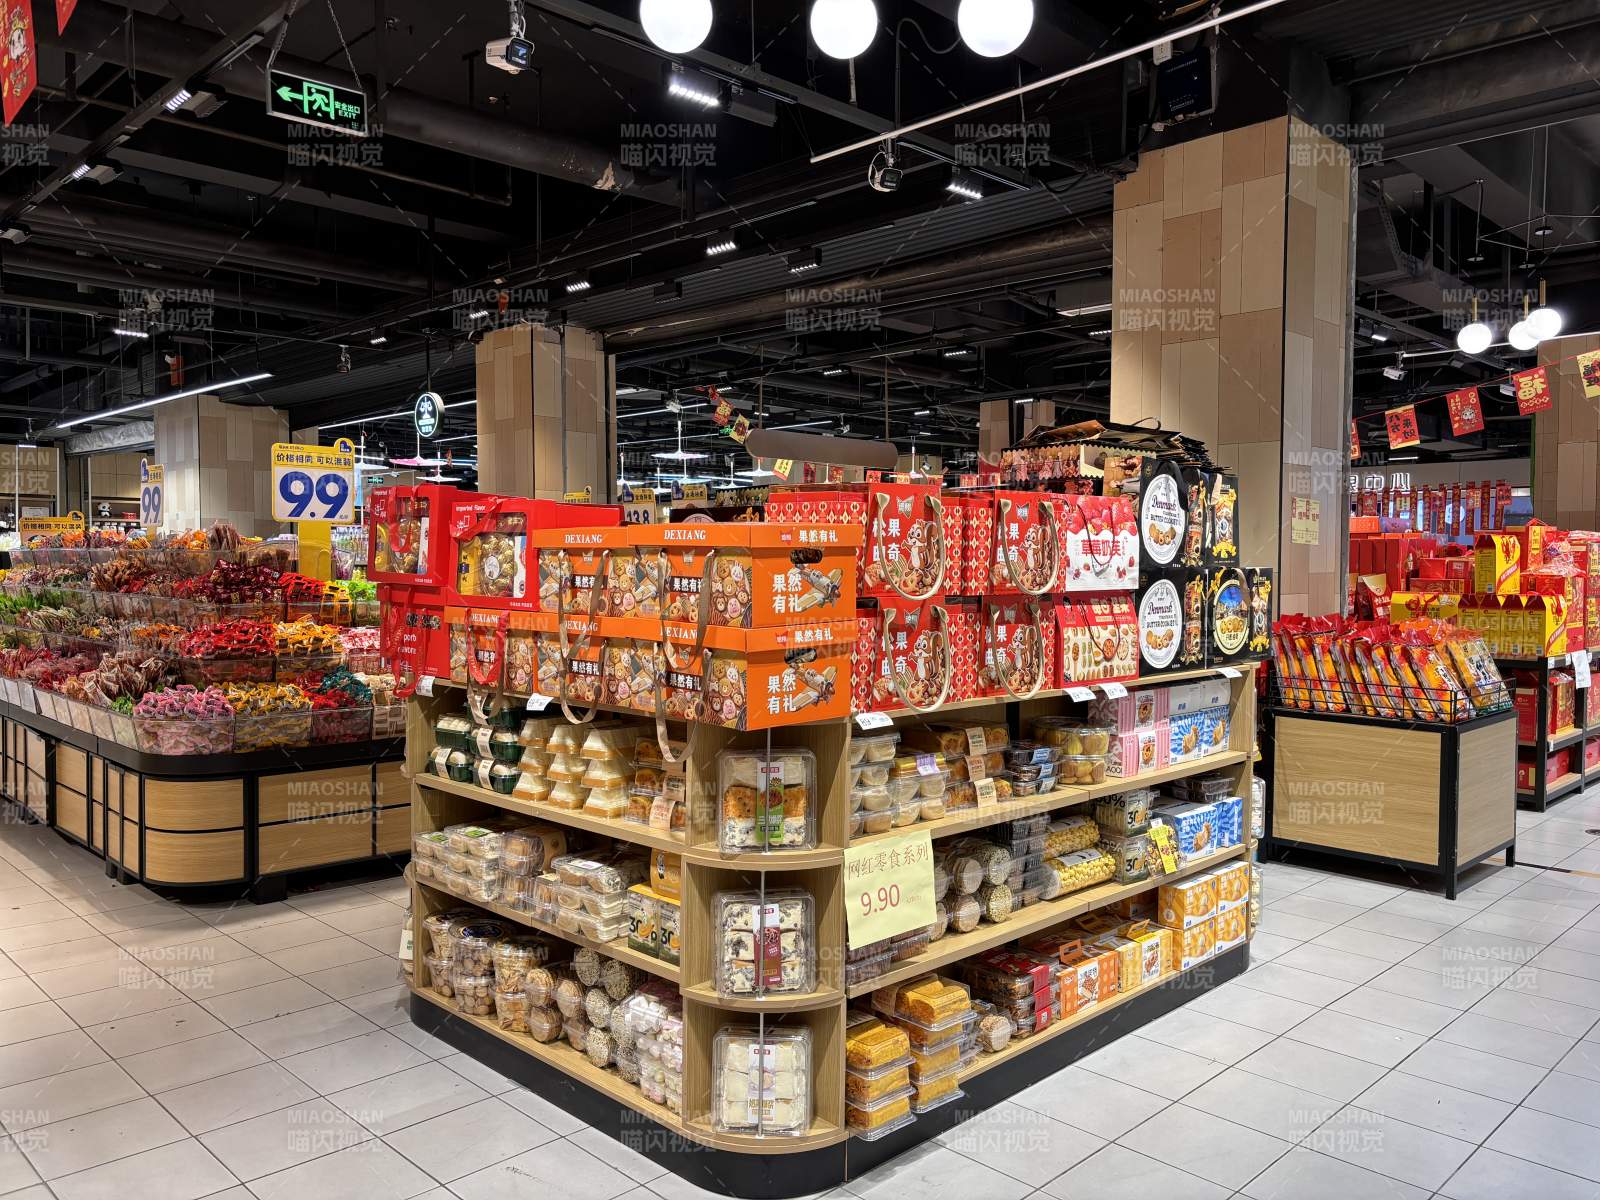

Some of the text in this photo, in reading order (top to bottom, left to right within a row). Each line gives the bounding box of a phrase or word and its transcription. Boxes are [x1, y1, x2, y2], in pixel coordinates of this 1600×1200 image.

[335, 100, 360, 114] 安全出口
[338, 109, 357, 119] EXIT
[279, 471, 349, 519] 9.9
[565, 534, 602, 544] DEXIANG
[664, 529, 706, 540] DEXIANG
[799, 529, 838, 543] 果然有礼
[772, 573, 801, 593] 果然
[772, 595, 801, 614] 有礼
[795, 627, 833, 643] 果然有礼
[767, 674, 796, 694] 果然
[767, 697, 797, 715] 有礼
[848, 841, 929, 880] 网红零食系列
[861, 884, 900, 917] 9.90
